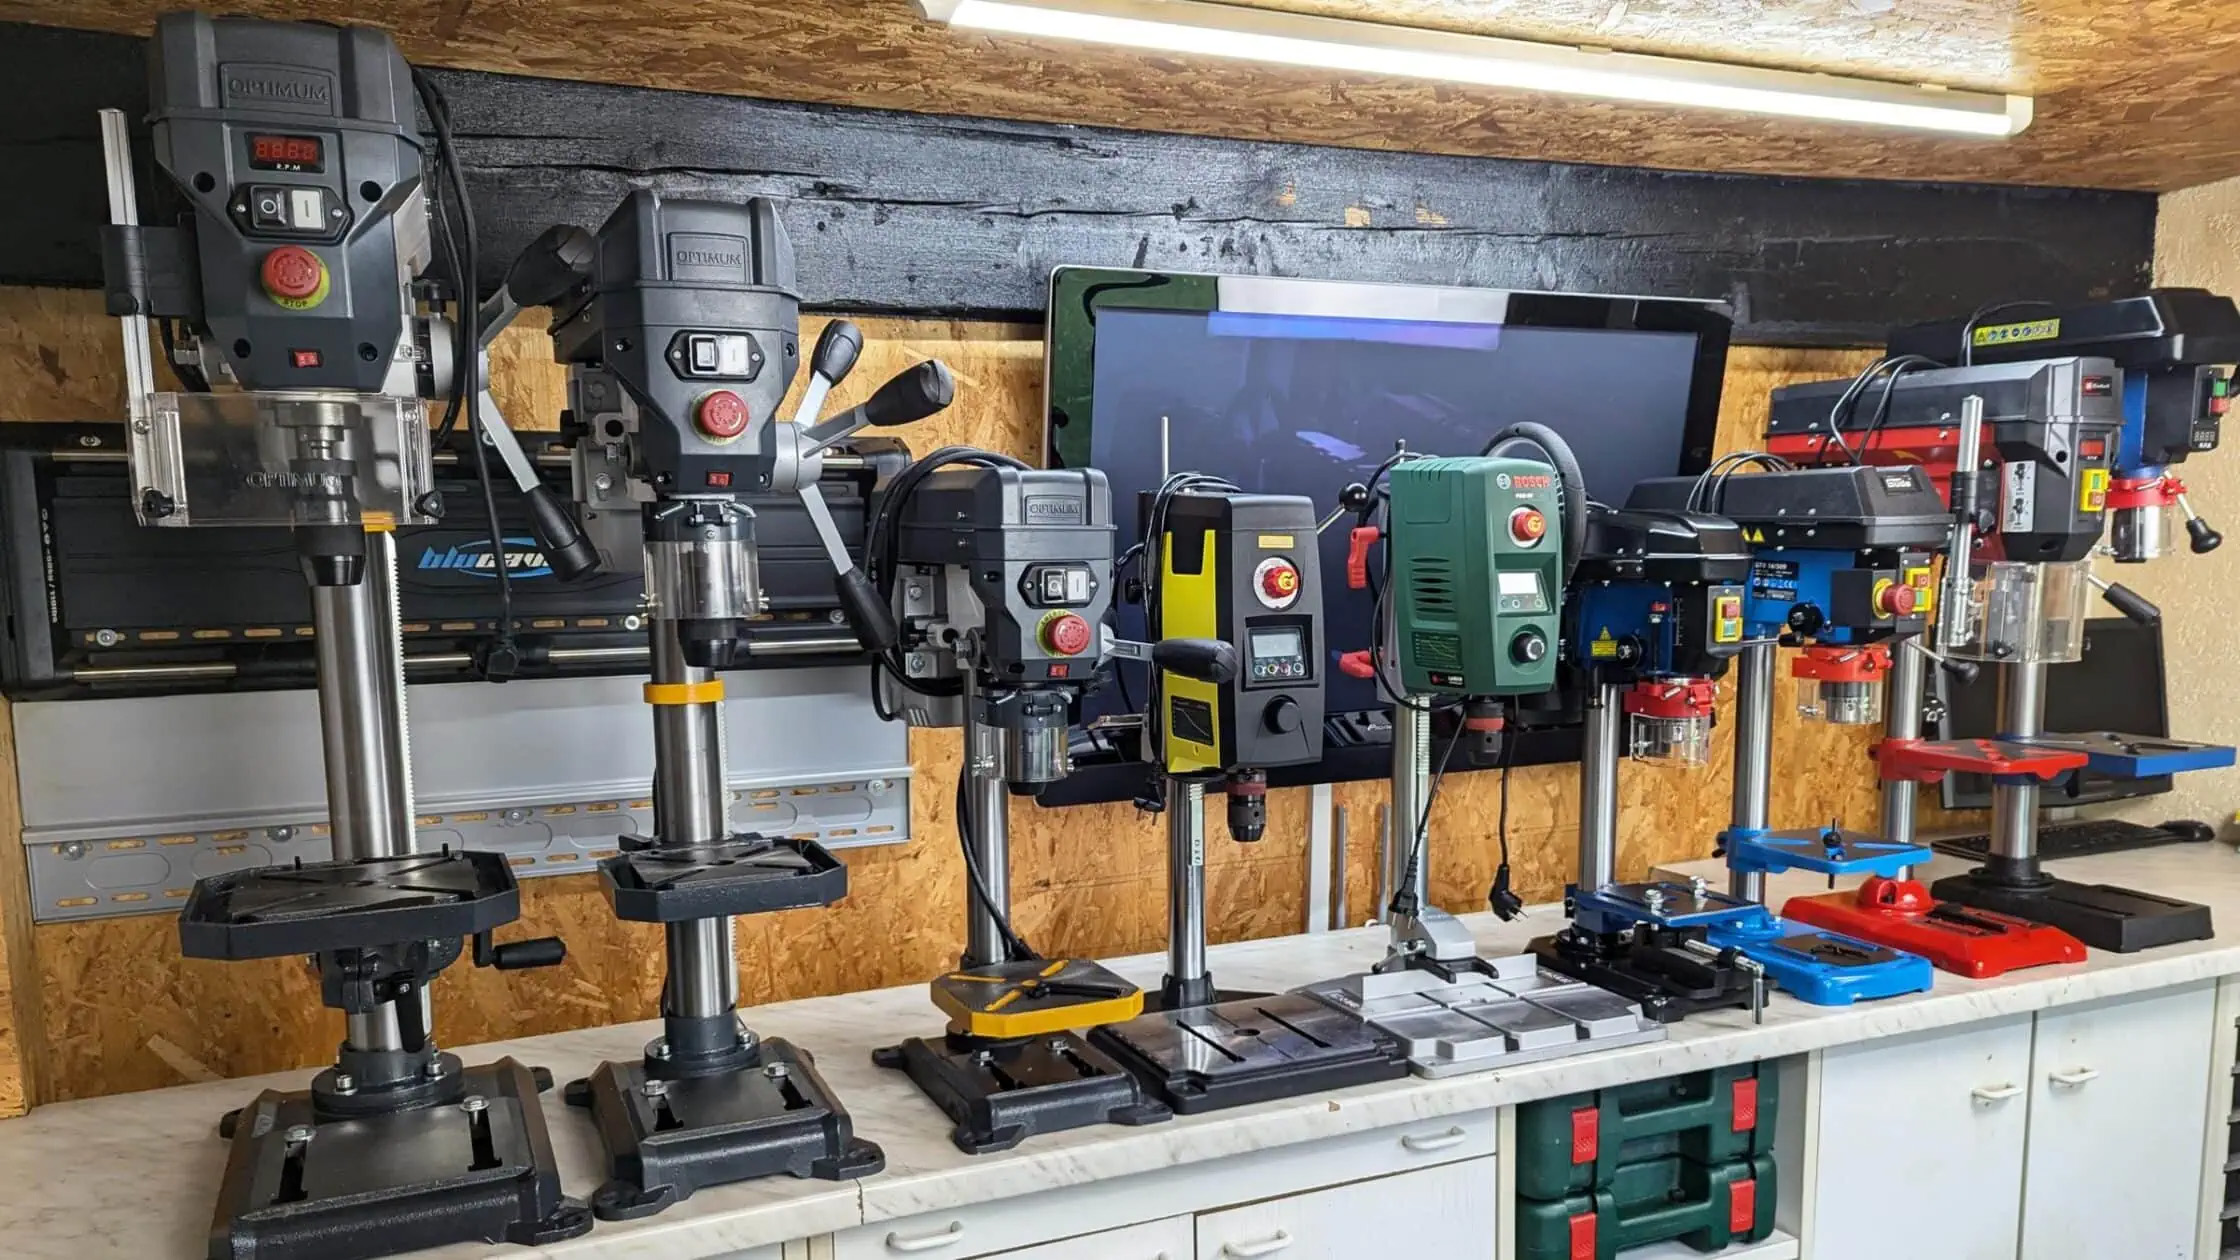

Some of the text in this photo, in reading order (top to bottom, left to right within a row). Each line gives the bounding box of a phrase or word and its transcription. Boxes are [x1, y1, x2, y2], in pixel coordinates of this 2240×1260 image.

[230, 78, 329, 102] OPTIMUM
[676, 250, 742, 266] OPTIMUM
[283, 298, 308, 308] STOP
[245, 471, 343, 488] OPTIMUM
[1512, 475, 1551, 488] BOSCH
[1029, 503, 1080, 514] OPTIMUM
